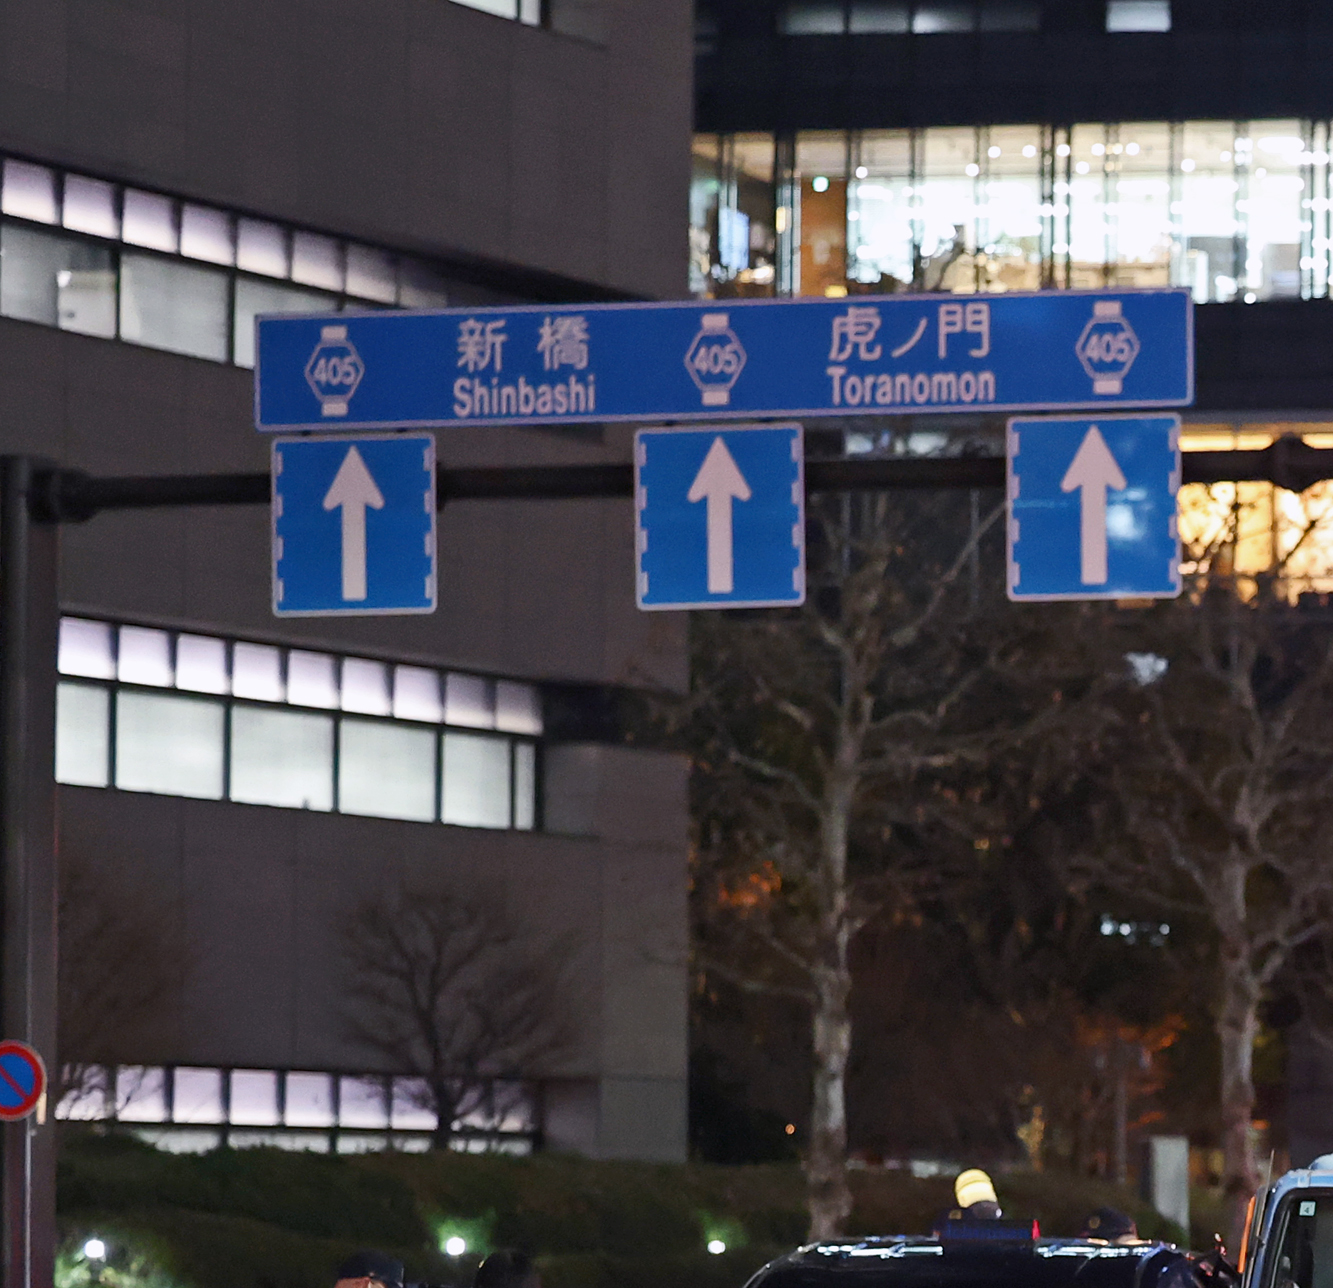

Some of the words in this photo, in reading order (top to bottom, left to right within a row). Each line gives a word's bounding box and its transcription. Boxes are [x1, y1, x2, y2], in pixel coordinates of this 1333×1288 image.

[457, 314, 590, 370] 新橋
[829, 303, 990, 361] 虎ノ門
[1085, 338, 1131, 363] 405
[313, 361, 356, 385] 405
[694, 350, 738, 374] 405
[452, 375, 595, 418] Shinbashi
[826, 366, 996, 406] Toranomon
